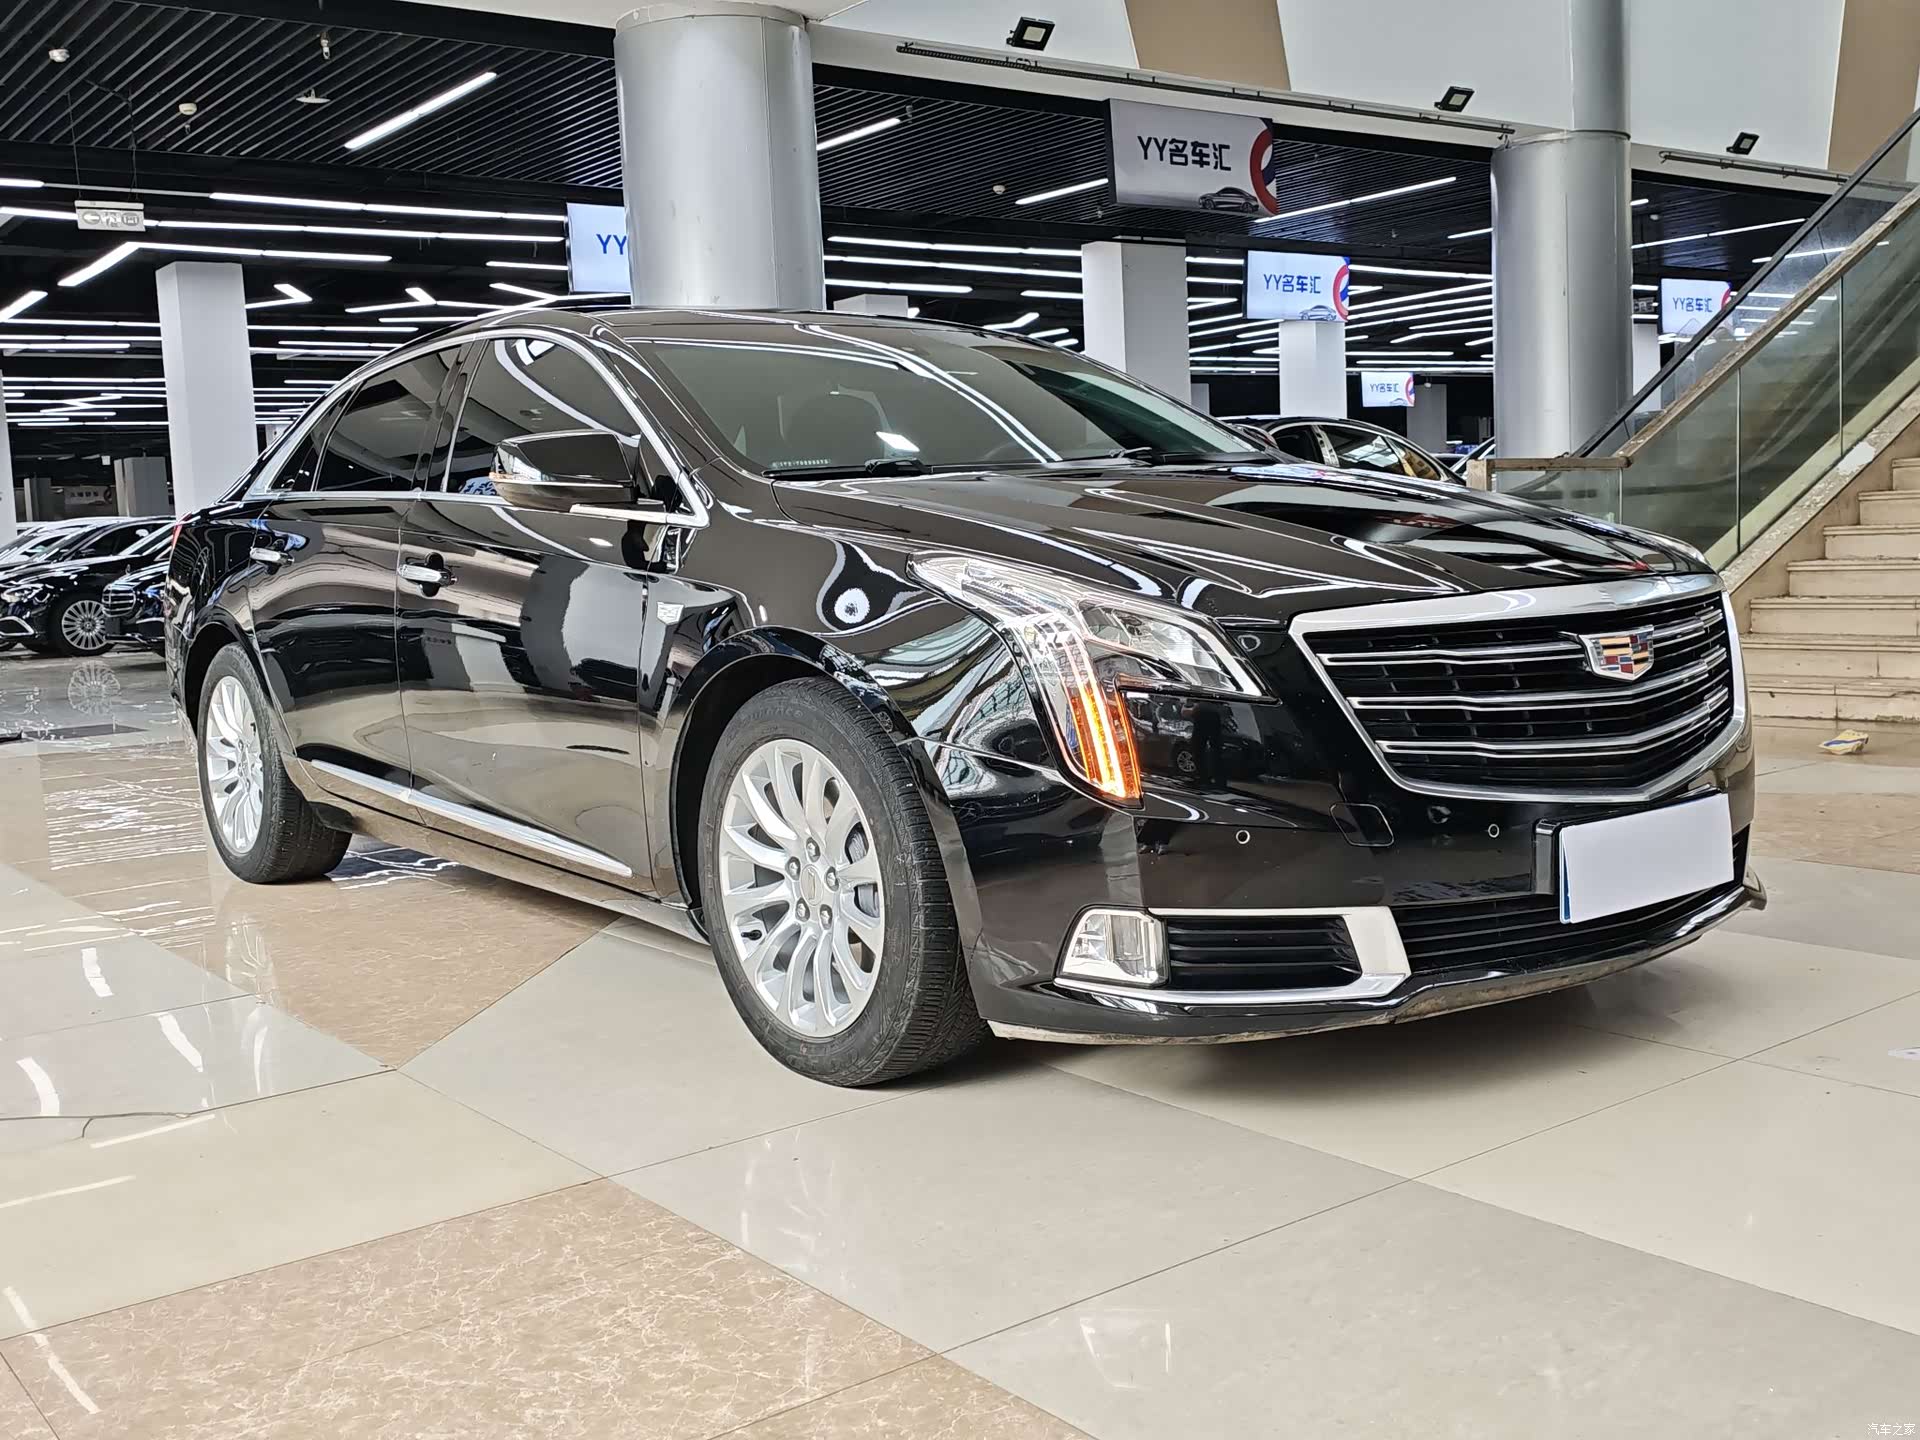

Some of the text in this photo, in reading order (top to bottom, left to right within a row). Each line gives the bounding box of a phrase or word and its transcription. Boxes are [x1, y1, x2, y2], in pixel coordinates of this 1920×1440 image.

[1137, 135, 1231, 171] YY名车汇
[1263, 273, 1321, 294] YY名车汇
